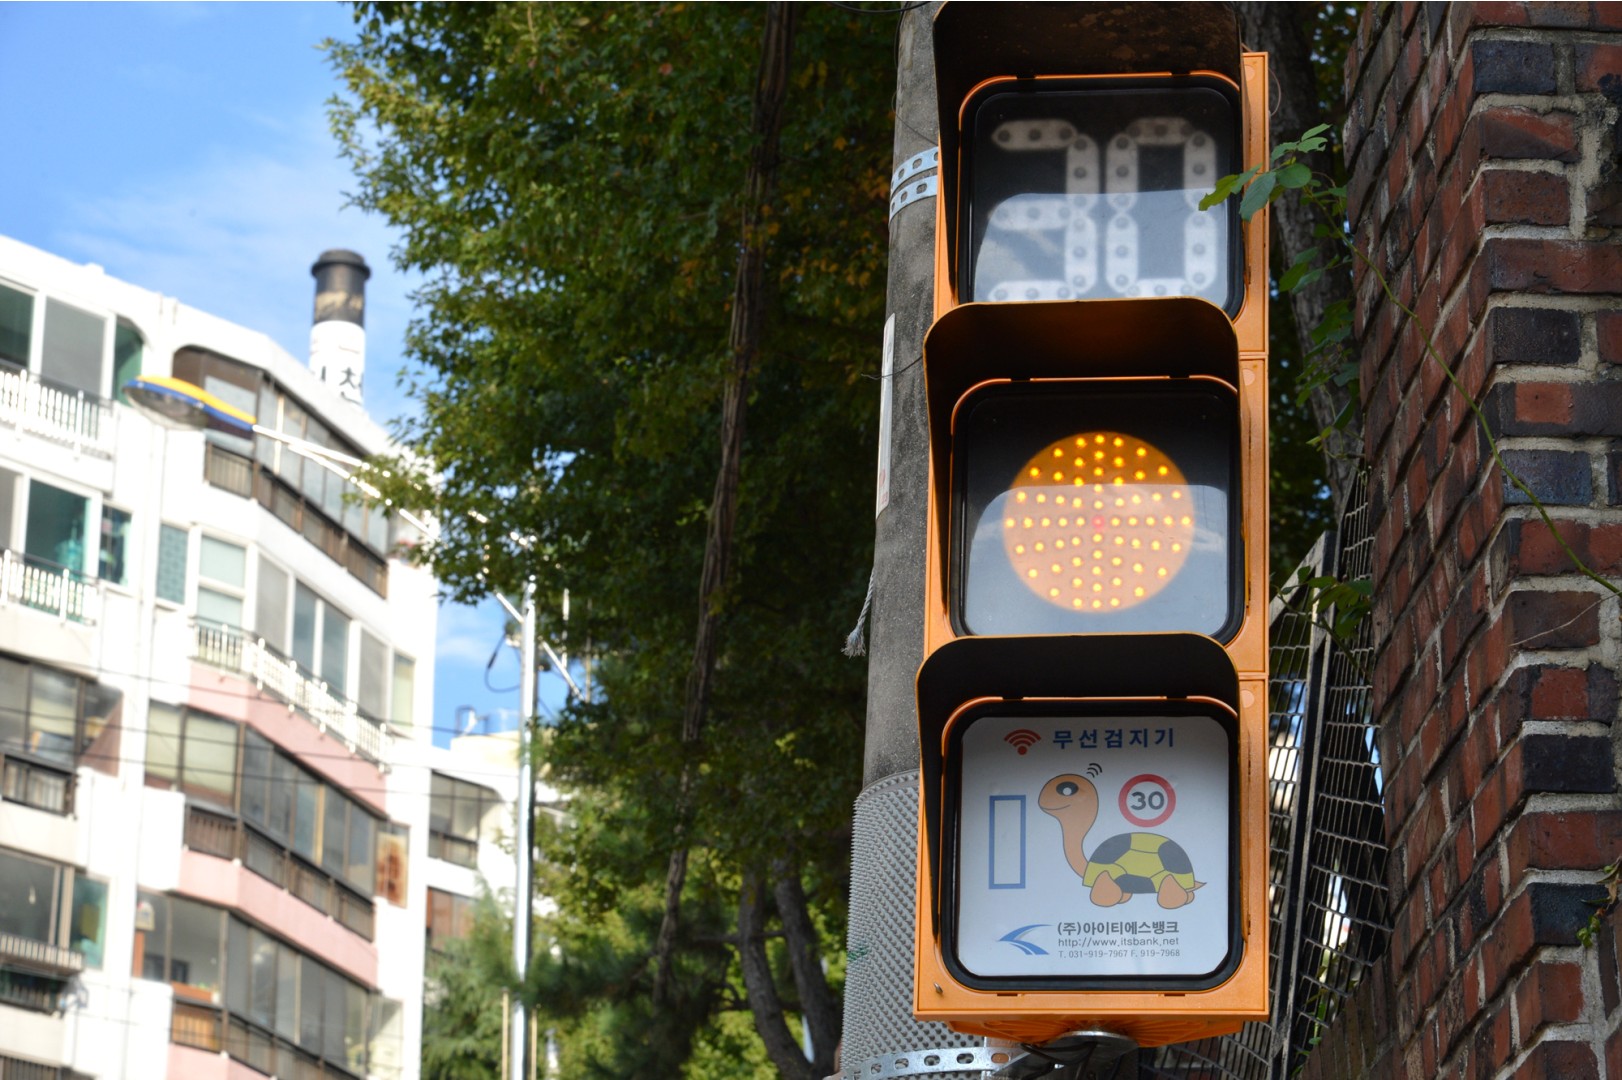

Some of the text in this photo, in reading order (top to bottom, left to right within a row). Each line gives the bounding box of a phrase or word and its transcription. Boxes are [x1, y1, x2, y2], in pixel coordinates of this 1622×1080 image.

[1053, 728, 1174, 748] 무선검지기
[1130, 791, 1165, 810] 30
[1057, 921, 1179, 935] (주)아이티에스뱅크
[1058, 937, 1179, 948] http://www.itsbank.net
[1069, 950, 1128, 958] 031-919-7967
[1141, 949, 1180, 958] 919-7968
